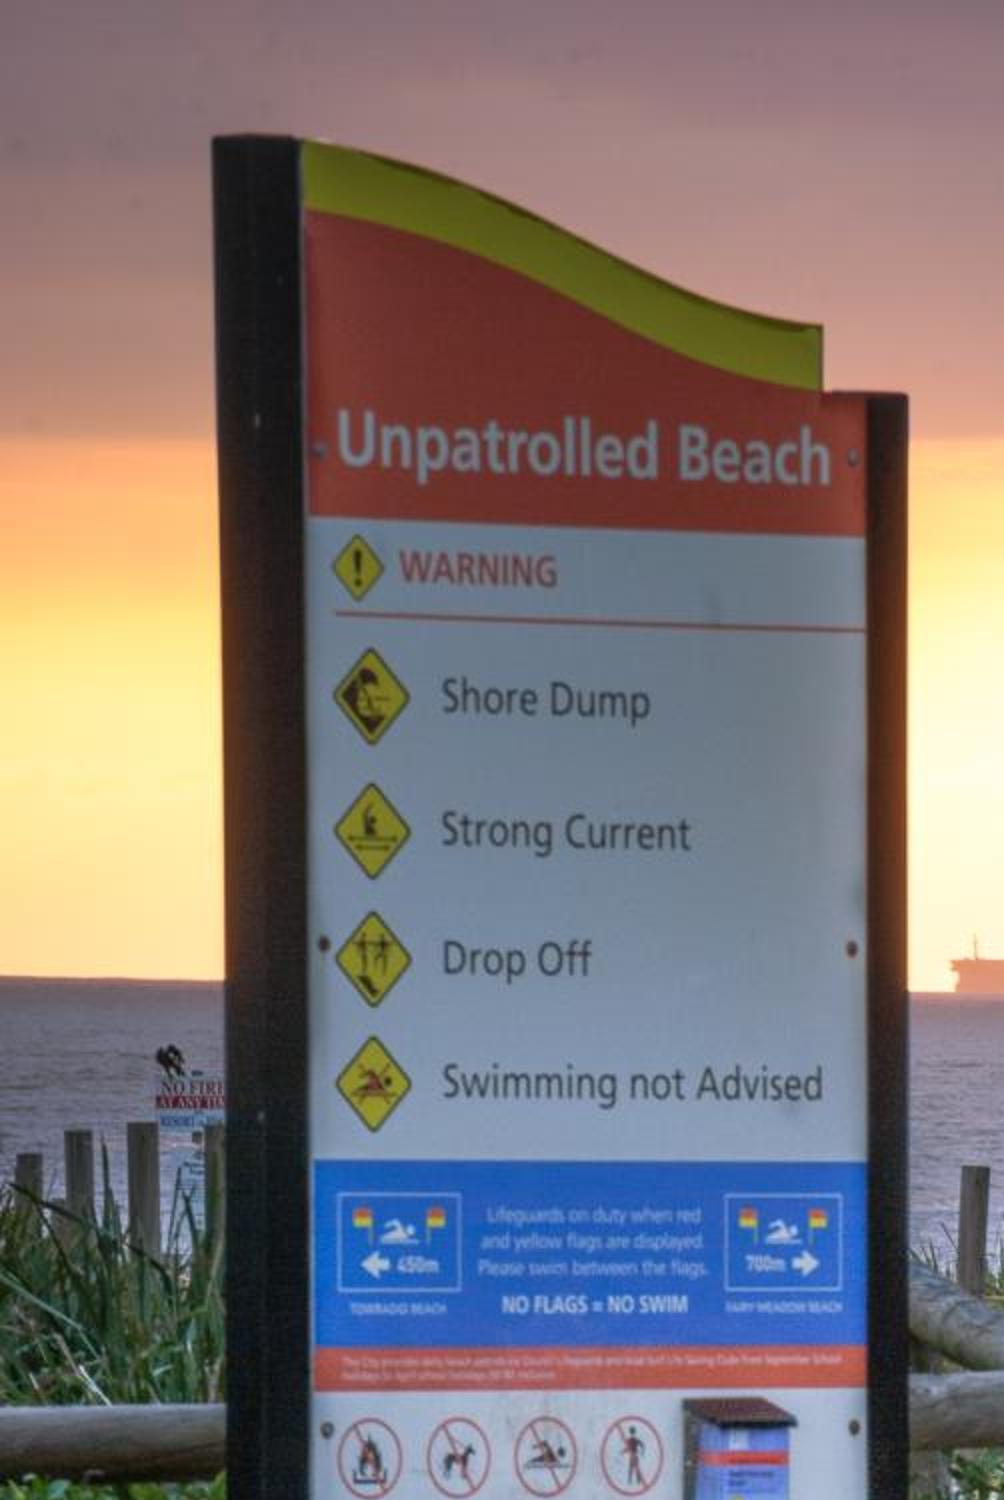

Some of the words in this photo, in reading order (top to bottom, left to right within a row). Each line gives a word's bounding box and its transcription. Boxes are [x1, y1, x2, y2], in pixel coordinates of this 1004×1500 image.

[337, 409, 659, 486] Unpatrolled
[678, 425, 831, 486] Beach
[399, 550, 558, 589] WARNING
[441, 677, 538, 716] Shore
[550, 682, 651, 727] Dump
[441, 810, 553, 858] Strong
[564, 814, 692, 852] Current
[443, 940, 526, 984] Drop
[537, 939, 593, 977] Off
[443, 1063, 618, 1110] Swimming
[629, 1071, 685, 1101] not
[696, 1065, 823, 1102] Advised
[486, 1208, 566, 1227] Lifeguards
[568, 1210, 589, 1223] on
[592, 1208, 627, 1226] duty
[631, 1208, 673, 1223] when
[676, 1208, 703, 1223] red
[481, 1233, 511, 1250] and
[513, 1233, 563, 1253] yellow
[567, 1233, 601, 1253] flags
[607, 1236, 631, 1250] are
[478, 1259, 527, 1276] Please
[528, 1259, 568, 1276] swim
[572, 1259, 639, 1276] between
[641, 1259, 666, 1276] the
[502, 1295, 530, 1314] NO
[533, 1295, 588, 1314] FLAGS
[607, 1295, 635, 1314] NO
[639, 1295, 689, 1314] SWIM
